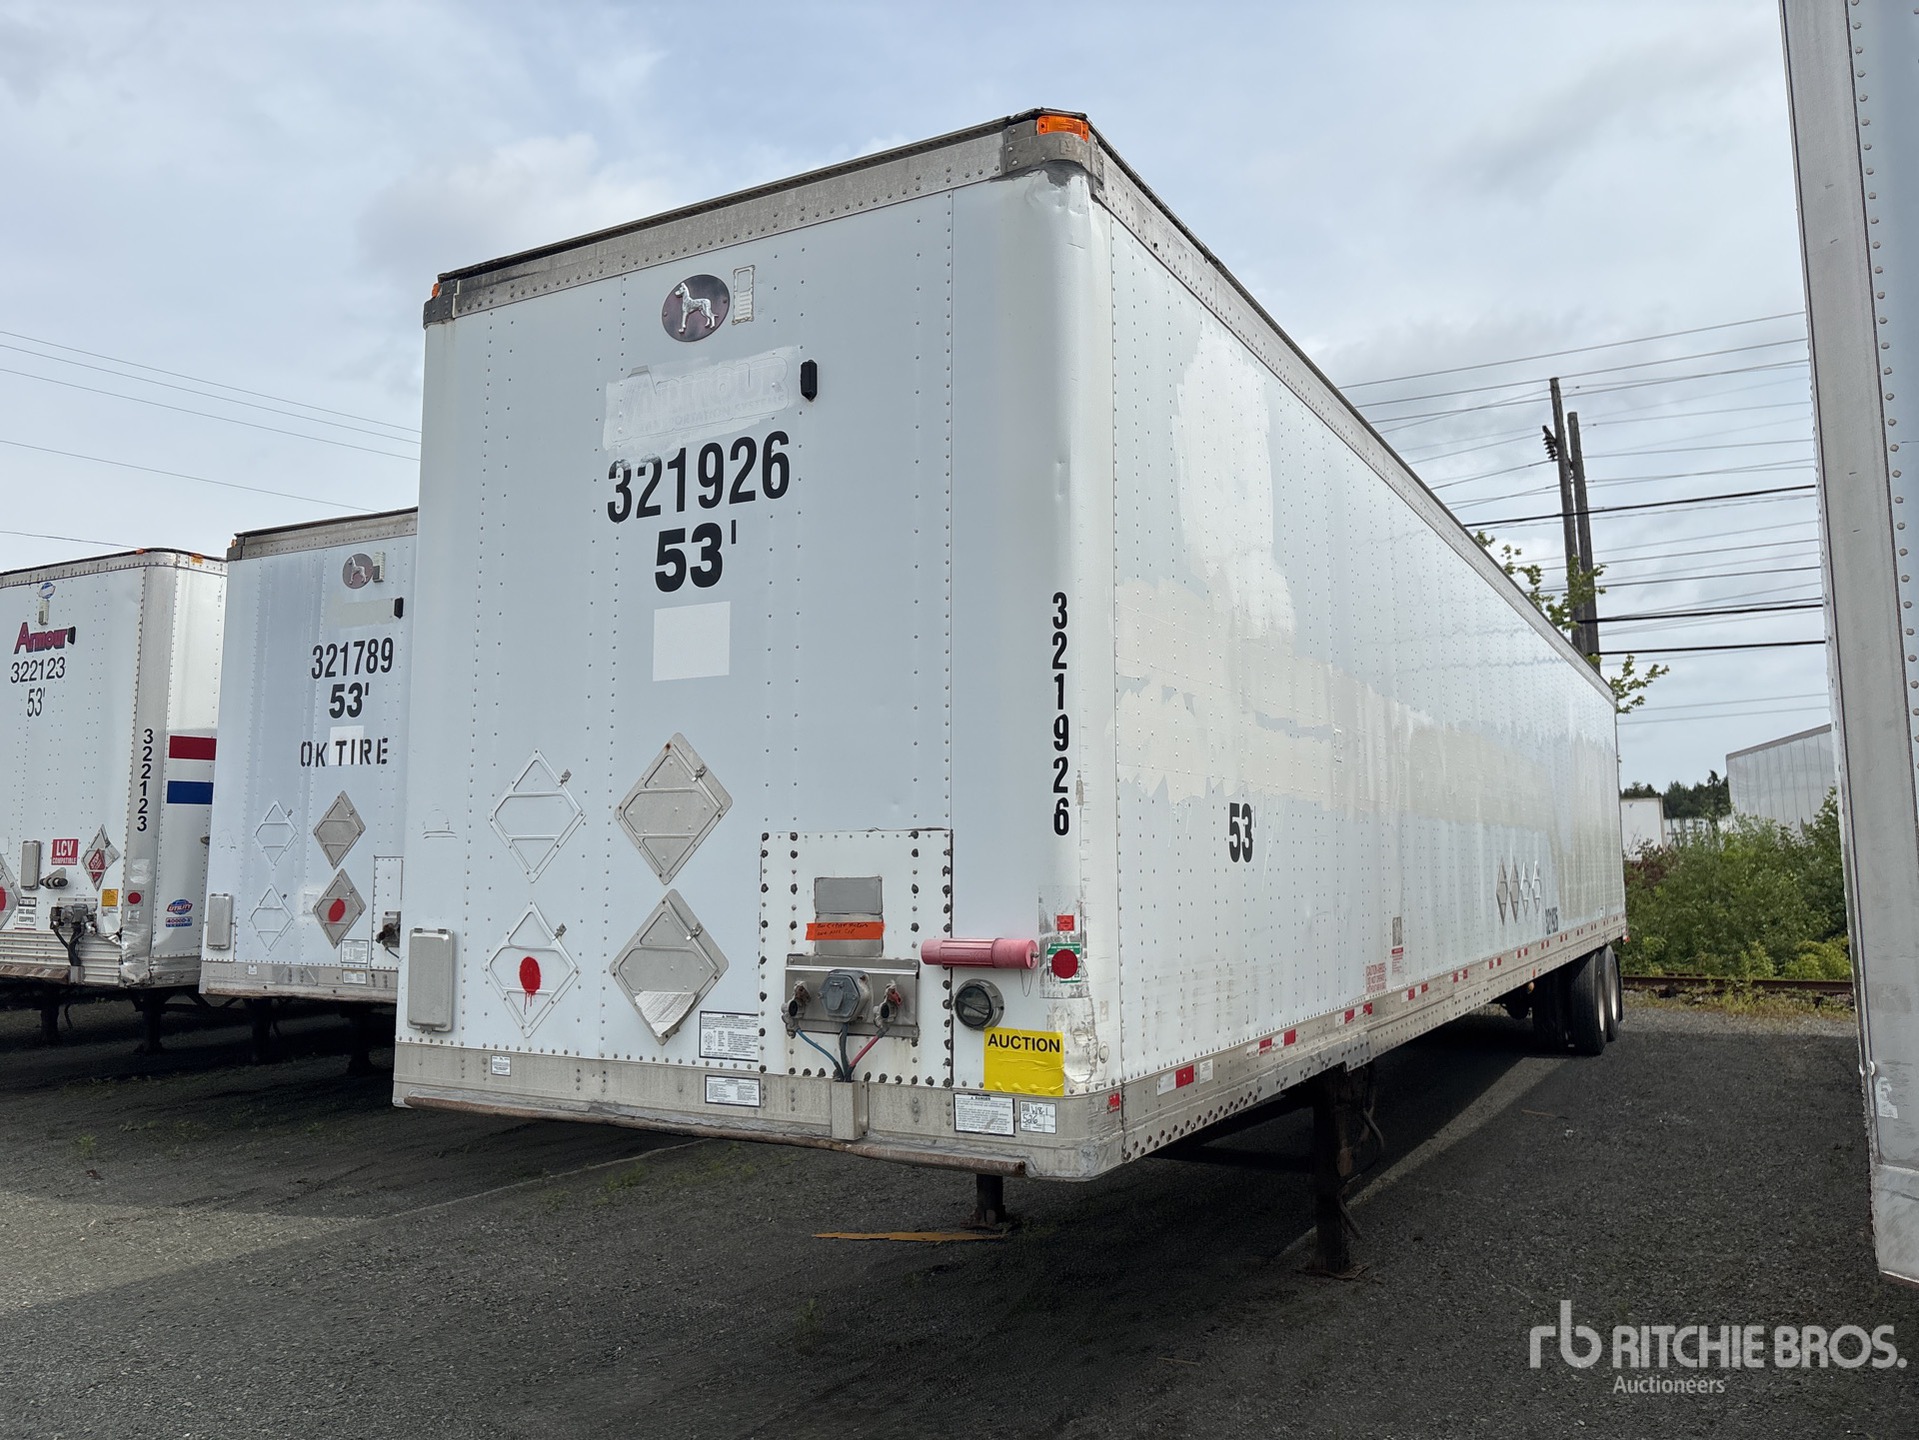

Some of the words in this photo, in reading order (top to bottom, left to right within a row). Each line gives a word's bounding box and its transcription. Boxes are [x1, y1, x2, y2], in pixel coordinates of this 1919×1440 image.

[607, 430, 790, 523] 321926
[654, 519, 737, 593] 53'
[10, 656, 66, 684] 322123
[311, 637, 394, 680] 321789
[328, 682, 370, 719] 53'
[1052, 591, 1069, 836] 321926
[300, 741, 328, 768] OK
[335, 737, 389, 767] TIRE
[52, 857, 77, 865] COMPATIBLE
[55, 840, 74, 857] LCV
[986, 1033, 1061, 1054] AUCTION
